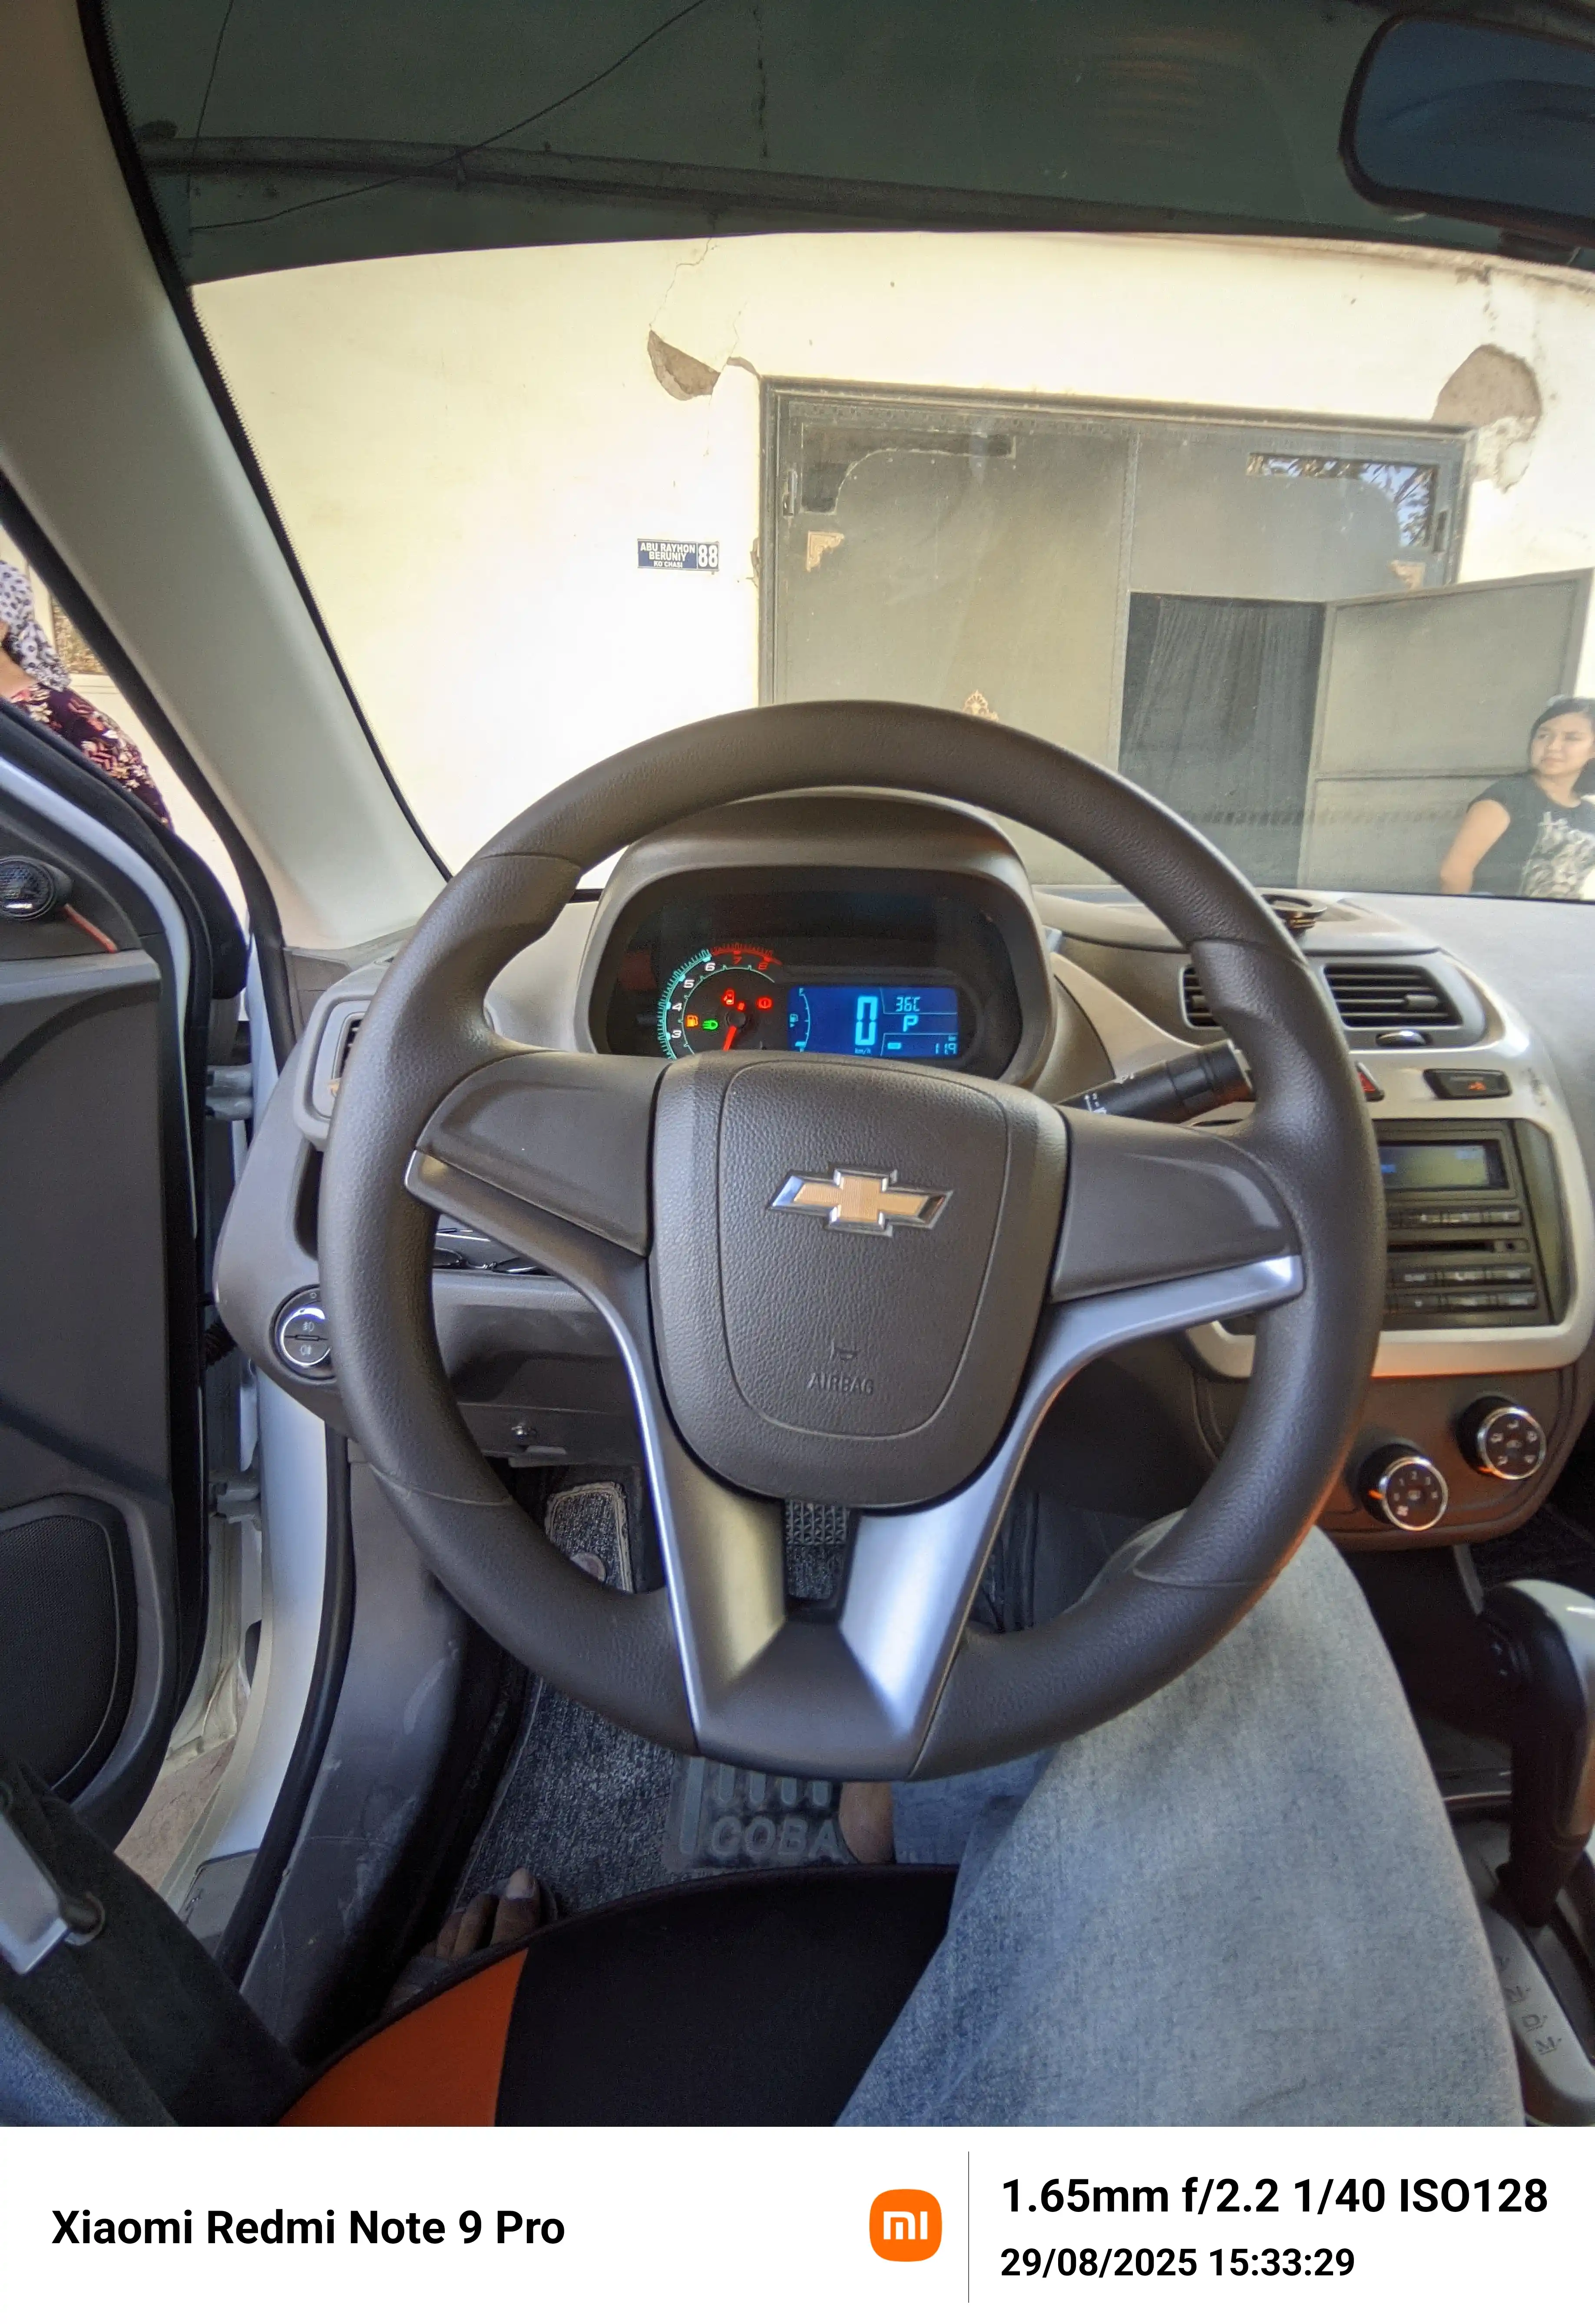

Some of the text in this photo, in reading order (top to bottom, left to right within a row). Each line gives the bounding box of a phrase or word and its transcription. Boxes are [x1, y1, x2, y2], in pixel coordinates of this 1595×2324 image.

[640, 543, 695, 553] ABU RAYHON
[649, 551, 687, 561] BERUNIY
[698, 545, 718, 567] 88
[705, 962, 715, 971] 6
[683, 979, 695, 988] 5
[672, 1003, 682, 1011] 4
[855, 996, 878, 1045] 0
[903, 1015, 919, 1032] P
[672, 1030, 682, 1038] 3
[807, 1372, 874, 1394] AIRBAG
